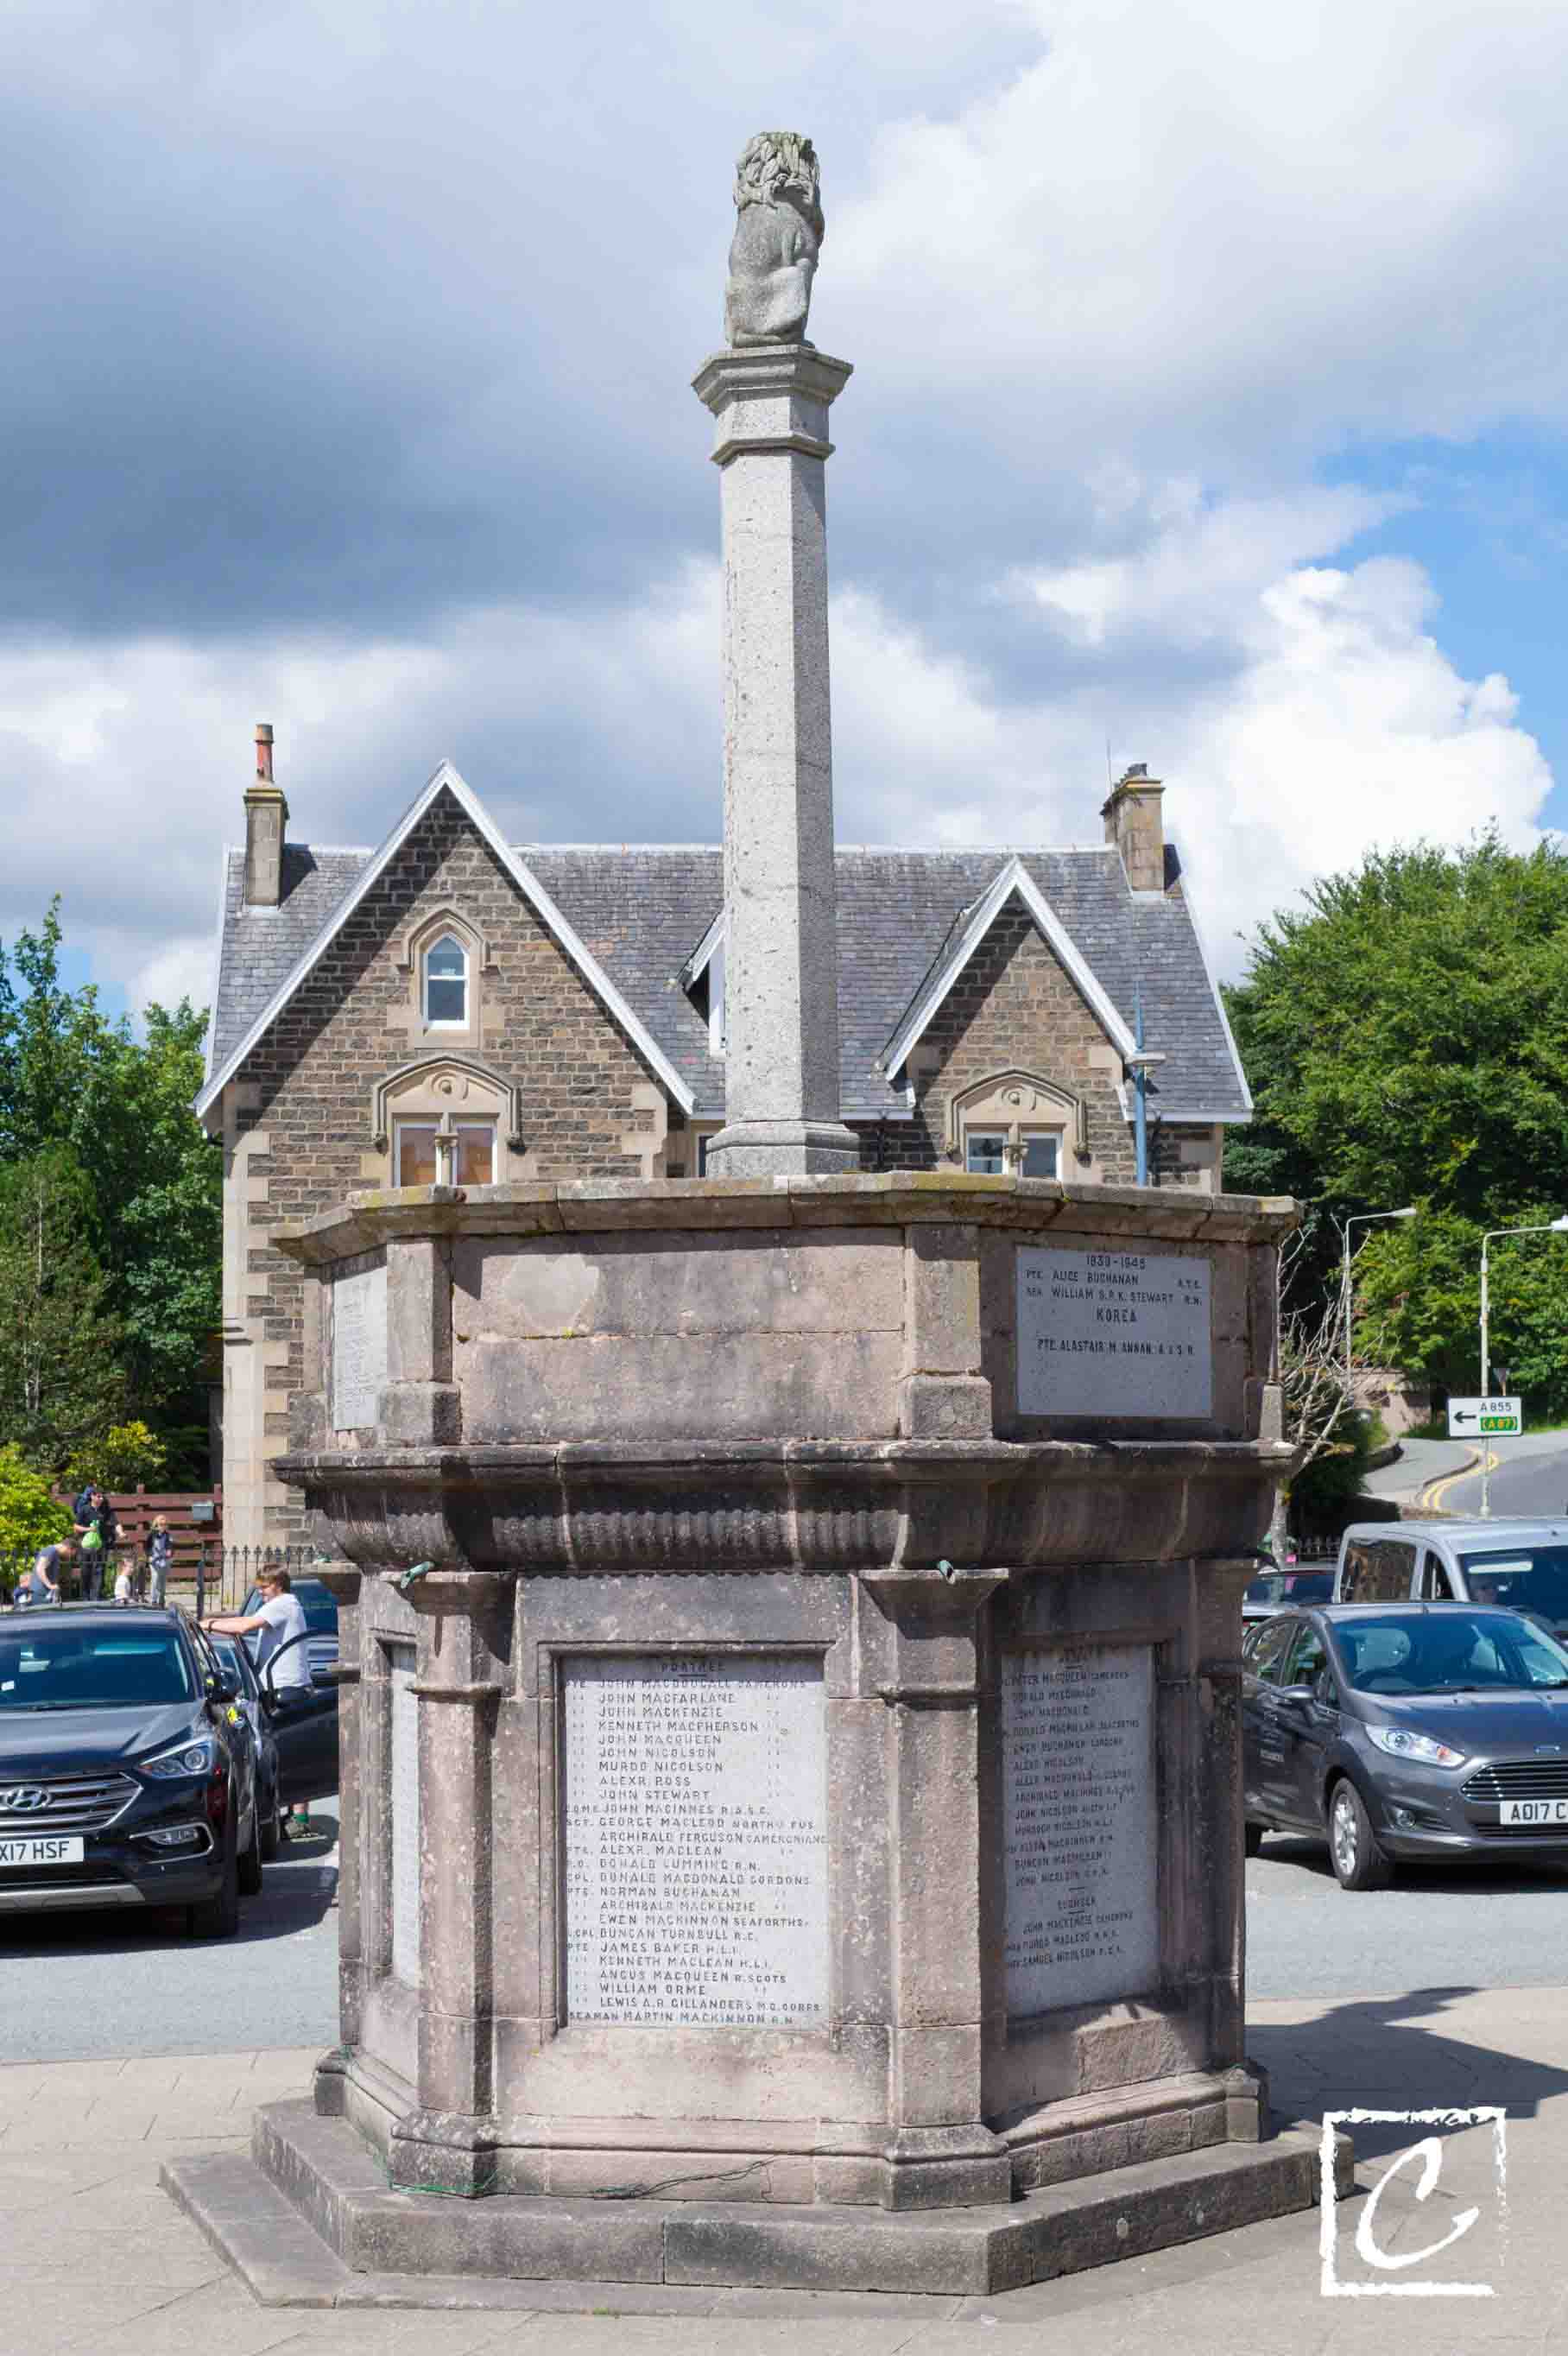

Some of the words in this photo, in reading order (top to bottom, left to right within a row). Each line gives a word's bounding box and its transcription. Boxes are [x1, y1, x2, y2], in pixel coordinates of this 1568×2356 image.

[1053, 1270, 1078, 1282] ALICE
[1086, 1271, 1139, 1285] BUCHANAN
[1052, 1285, 1093, 1300] WILLIAM
[1130, 1292, 1173, 1306] STEWART
[1096, 1307, 1138, 1323] KOREA
[1059, 1340, 1104, 1353] ALASTAIR
[599, 1679, 635, 1689] JOHN
[598, 1694, 636, 1704] JOHN
[642, 1694, 737, 1704] MACFARLANE
[598, 1707, 636, 1718] JOHN
[642, 1707, 724, 1719] MACKENZIE
[598, 1721, 661, 1732] KENNETH
[667, 1721, 759, 1732] MACPHERSON
[598, 1734, 636, 1745] JOHN
[644, 1734, 722, 1745] MACQUEEN
[598, 1748, 636, 1758] JOHN
[645, 1748, 717, 1759] NICOLSON
[598, 1761, 648, 1771] MURDO
[654, 1761, 724, 1772] NICOLSON
[655, 1776, 691, 1787] ROSS
[598, 1789, 637, 1800] JOHN
[644, 1789, 711, 1801] STEWART
[603, 1803, 638, 1814] JOHN
[645, 1804, 714, 1814] MACINNES
[598, 1817, 653, 1827] GEORGE
[661, 1818, 724, 1828] MACLEOD
[600, 1832, 673, 1842] ARCHIBALD
[680, 1833, 743, 1844] FERGUSON
[32, 1840, 69, 1859] HSF
[655, 1846, 723, 1856] MACLEAN
[600, 1859, 656, 1869] DONALD
[663, 1872, 744, 1884] MACDONALD
[600, 1887, 657, 1897] NORMAN
[663, 1887, 741, 1898] BUCHANAN
[600, 1900, 673, 1911] ARCHIBALD
[680, 1901, 756, 1912] MACKENZIE
[599, 1914, 637, 1925] EWEN
[645, 1915, 729, 1926] MACKINNON
[600, 1928, 656, 1939] DUNCAN
[661, 1928, 728, 1941] TURNBULL
[600, 1942, 648, 1953] JAMES
[654, 1943, 699, 1954] BAKER
[599, 1956, 661, 1966] KENNETH
[667, 1957, 733, 1967] MACLEAN
[600, 1970, 646, 1981] ANGUS
[654, 1971, 729, 1982] MACQUEEN
[599, 1983, 657, 1994] WILLIAM
[666, 1985, 706, 1995] ORME
[600, 1997, 637, 2008] LEWIS
[671, 1998, 753, 2011] GILLANDERS
[569, 2011, 619, 2021] SEAMAN
[623, 2011, 673, 2022] MARTIN
[680, 2012, 765, 2024] MACKINNON
